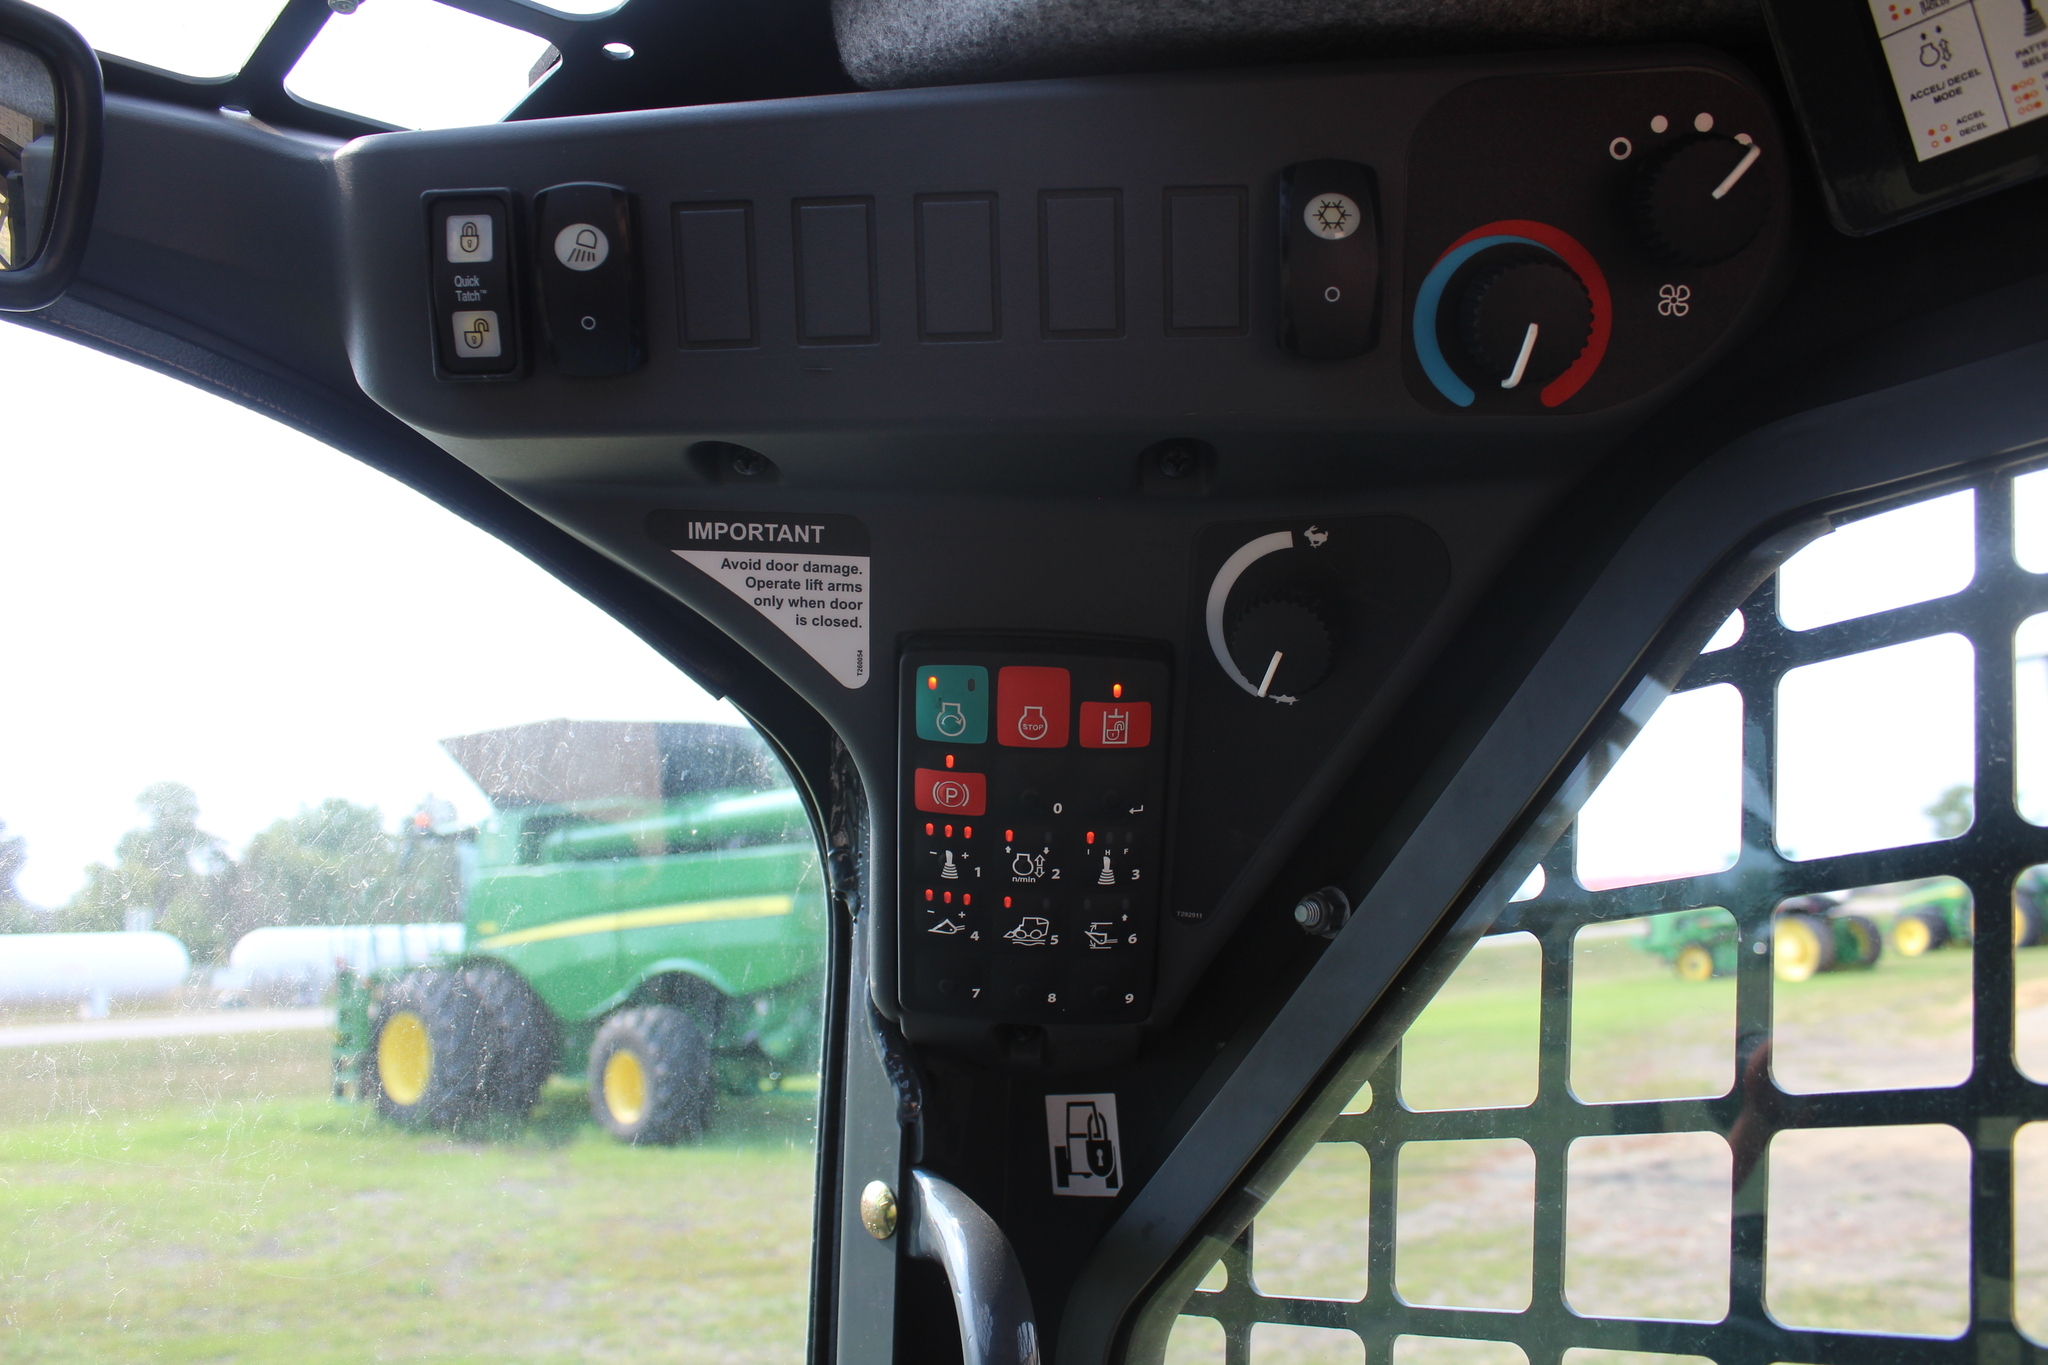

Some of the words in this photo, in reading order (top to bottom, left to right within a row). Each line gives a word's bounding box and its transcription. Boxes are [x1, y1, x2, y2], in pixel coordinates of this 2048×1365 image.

[1909, 81, 1946, 102] ACCEL/
[1947, 68, 1982, 87] DECEL
[1933, 86, 1963, 104] MODE
[1956, 110, 1985, 125] ACCEL
[1959, 122, 1988, 137] DECEL
[454, 275, 480, 288] Quick
[688, 521, 825, 544] IMPORTANT
[720, 557, 762, 571] Avoid
[765, 559, 799, 572] door
[802, 561, 863, 577] damage.
[745, 576, 801, 592] Operate
[805, 578, 824, 591] lift
[827, 582, 863, 593] arms
[753, 595, 784, 610] only
[788, 597, 826, 609] when
[829, 598, 863, 611] door
[795, 614, 807, 626] is
[811, 615, 863, 628] closed.
[1022, 723, 1044, 732] STOP
[945, 787, 958, 804] P
[1053, 803, 1063, 814] 0
[974, 867, 981, 878] 1
[1051, 869, 1061, 880] 2
[1131, 869, 1140, 880] 3
[1012, 875, 1036, 883] n/min
[970, 931, 980, 941] 4
[1050, 935, 1059, 945] 5
[1127, 934, 1137, 944] 6
[972, 988, 981, 998] 7
[1047, 993, 1057, 1003] 8
[1125, 993, 1134, 1003] 9
